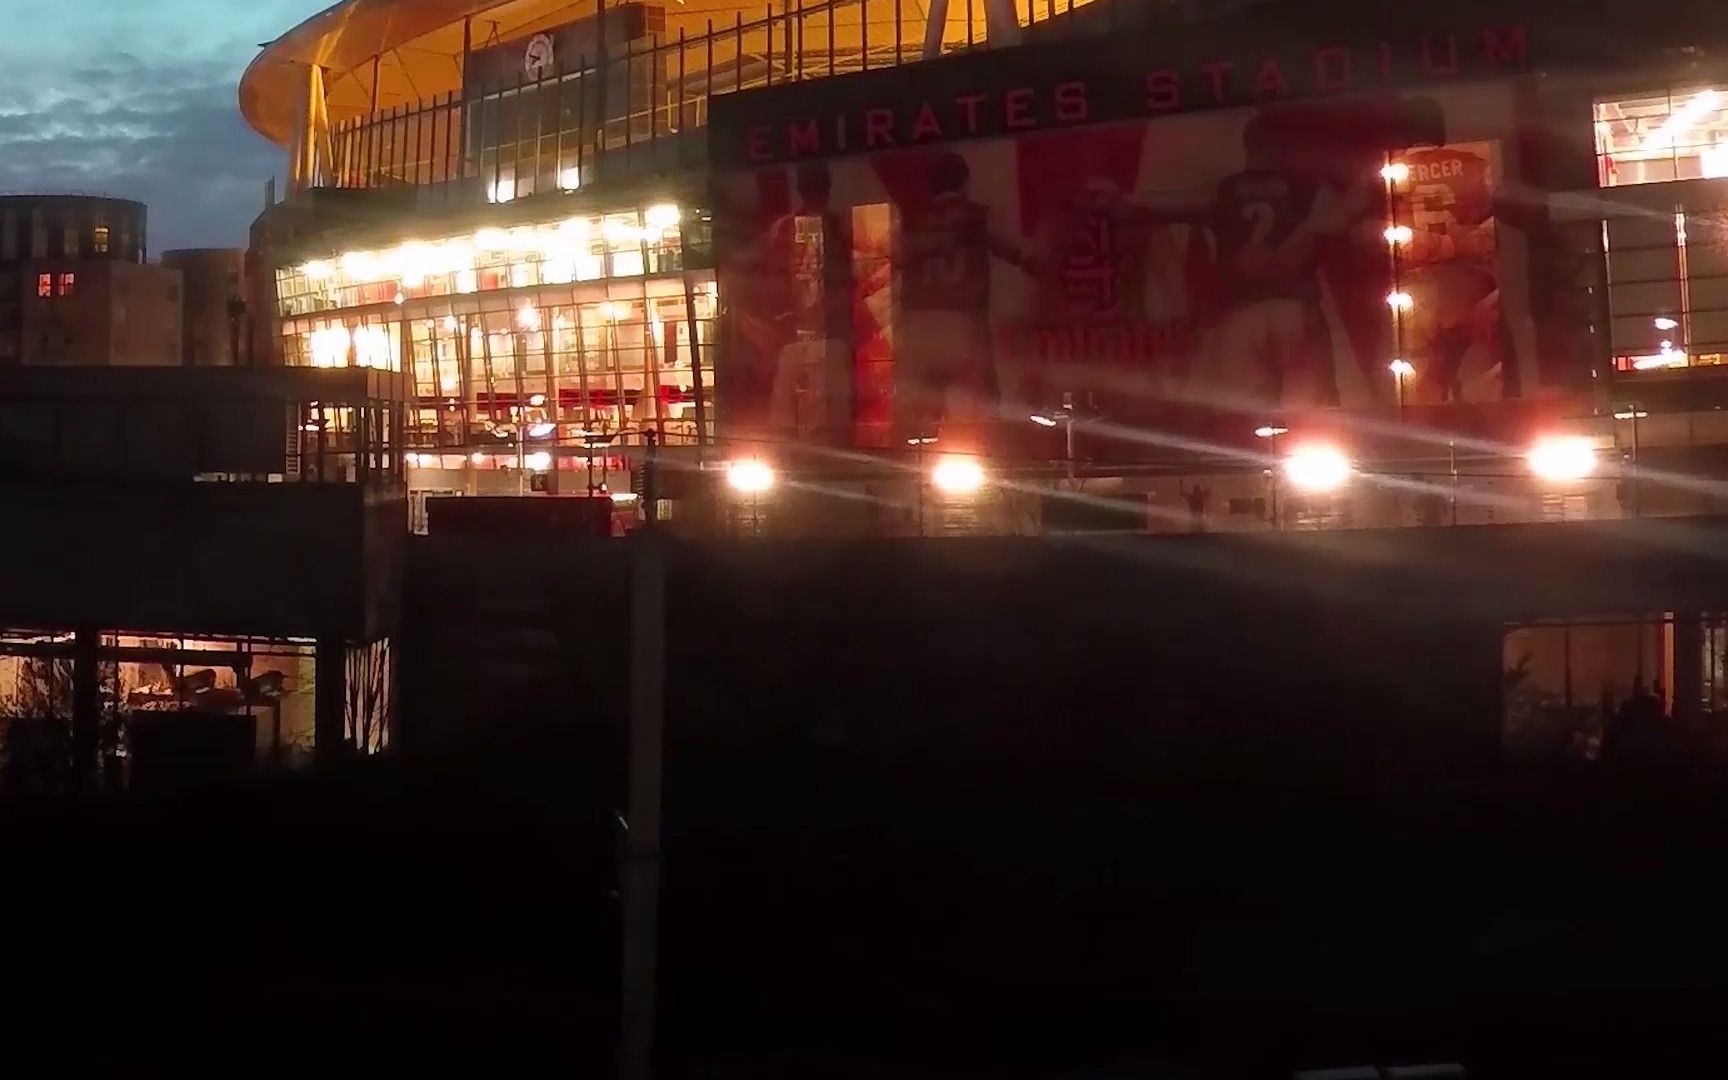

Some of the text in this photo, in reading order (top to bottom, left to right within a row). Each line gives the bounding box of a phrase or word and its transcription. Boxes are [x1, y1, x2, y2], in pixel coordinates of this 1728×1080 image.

[750, 27, 1525, 159] EMIRATES STADIUM
[1400, 159, 1464, 181] ERCER
